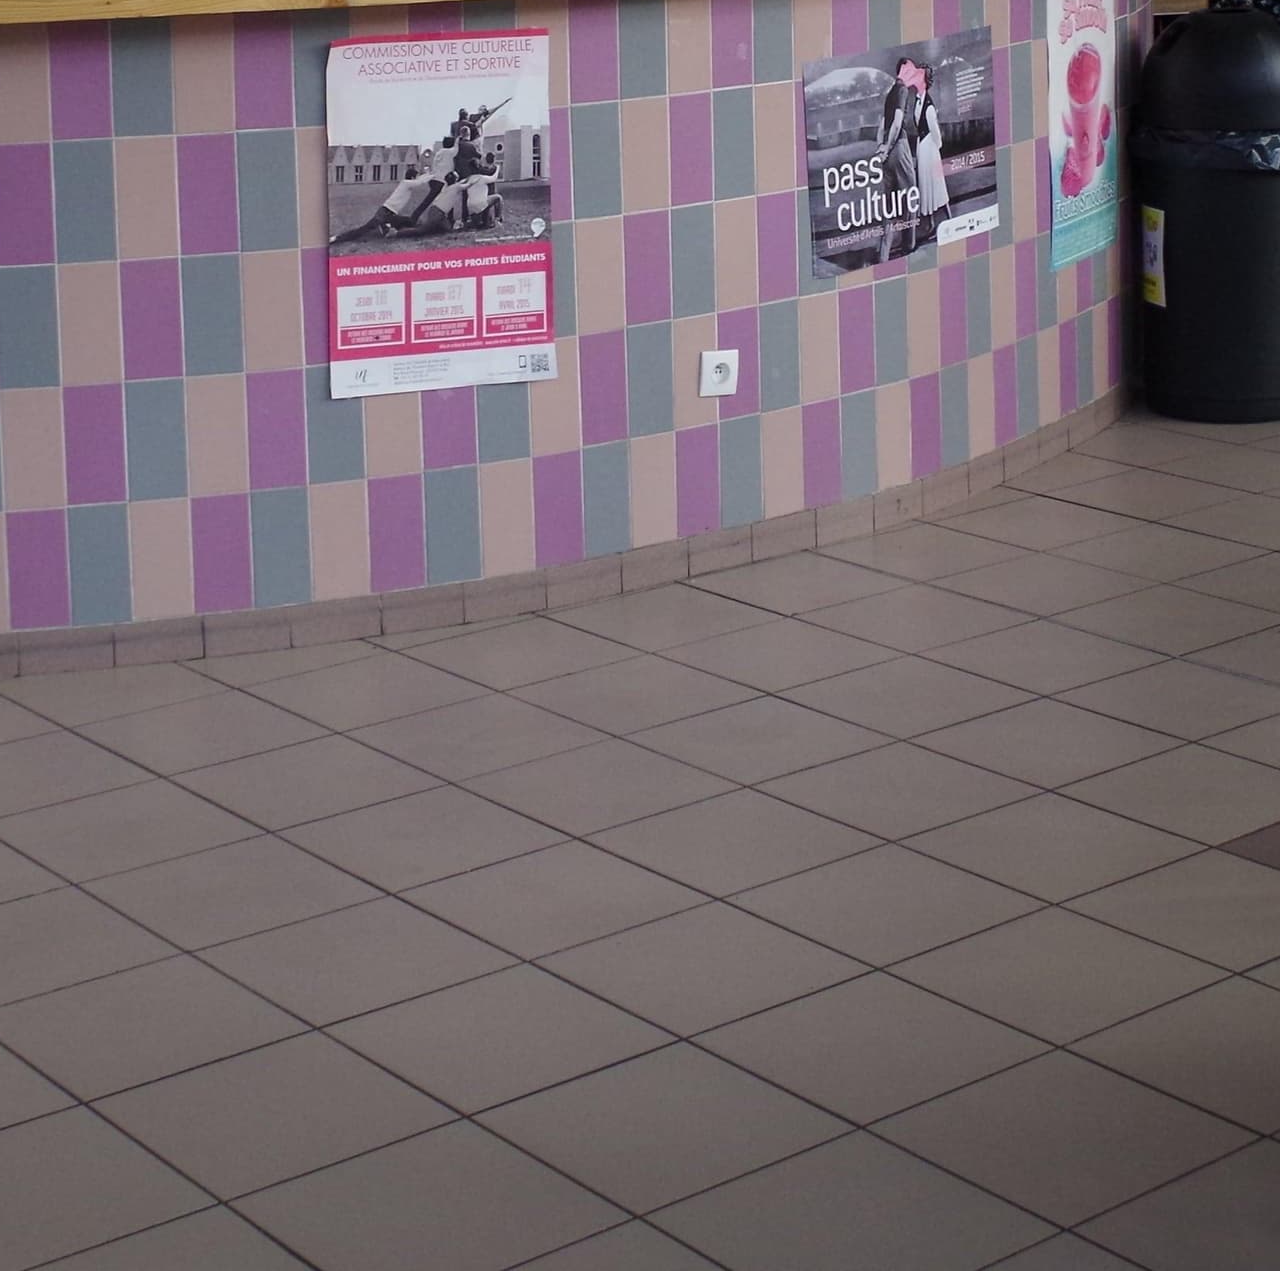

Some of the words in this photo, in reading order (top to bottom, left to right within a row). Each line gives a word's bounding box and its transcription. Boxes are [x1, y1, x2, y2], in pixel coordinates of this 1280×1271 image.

[342, 42, 434, 60] COMMISSION
[439, 41, 457, 56] VIE
[463, 38, 535, 54] CULTURELLE,
[358, 59, 441, 76] ASSOCIATIVE
[446, 59, 459, 71] ET
[464, 56, 521, 72] SPORTIVE
[823, 157, 884, 208] pass
[837, 185, 920, 231] culture
[337, 268, 350, 277] UN
[353, 263, 415, 275] FINANCEMENT
[417, 262, 442, 271] POUR
[444, 259, 463, 269] VOS
[465, 256, 499, 268] PROJETS
[501, 253, 546, 265] ÉTUDIANTS
